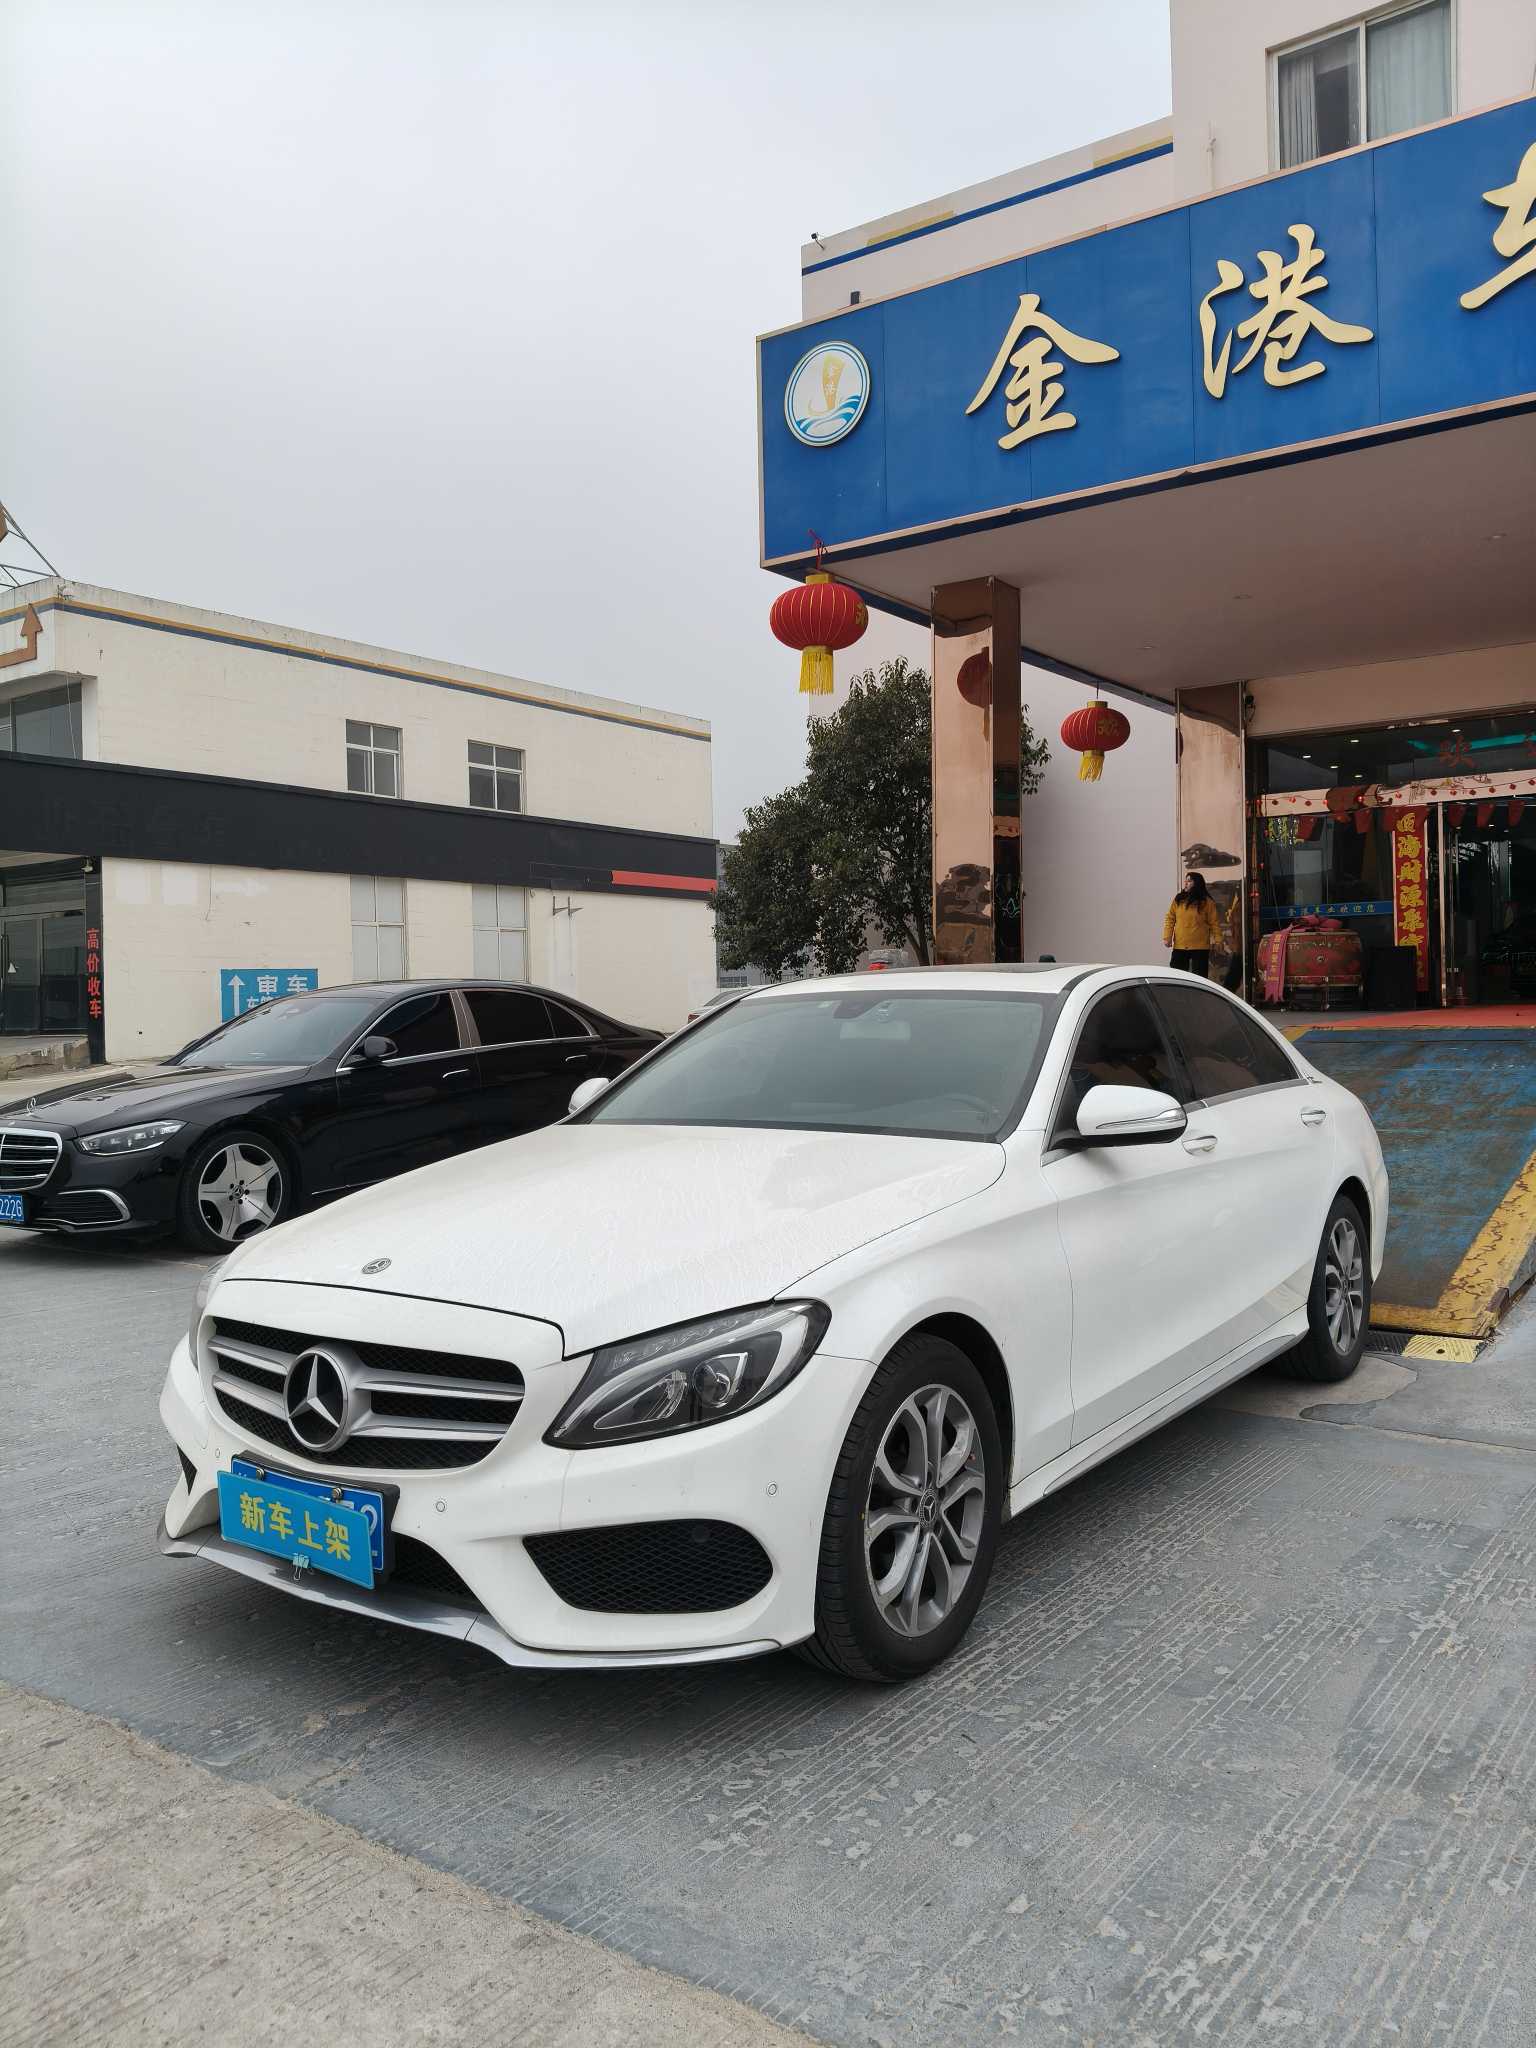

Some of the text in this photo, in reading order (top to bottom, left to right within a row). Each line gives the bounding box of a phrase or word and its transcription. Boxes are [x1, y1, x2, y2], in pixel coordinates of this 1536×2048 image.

[86, 927, 103, 1020] 高价收车
[256, 974, 309, 995] 审车
[239, 1491, 352, 1562] 新车上架
